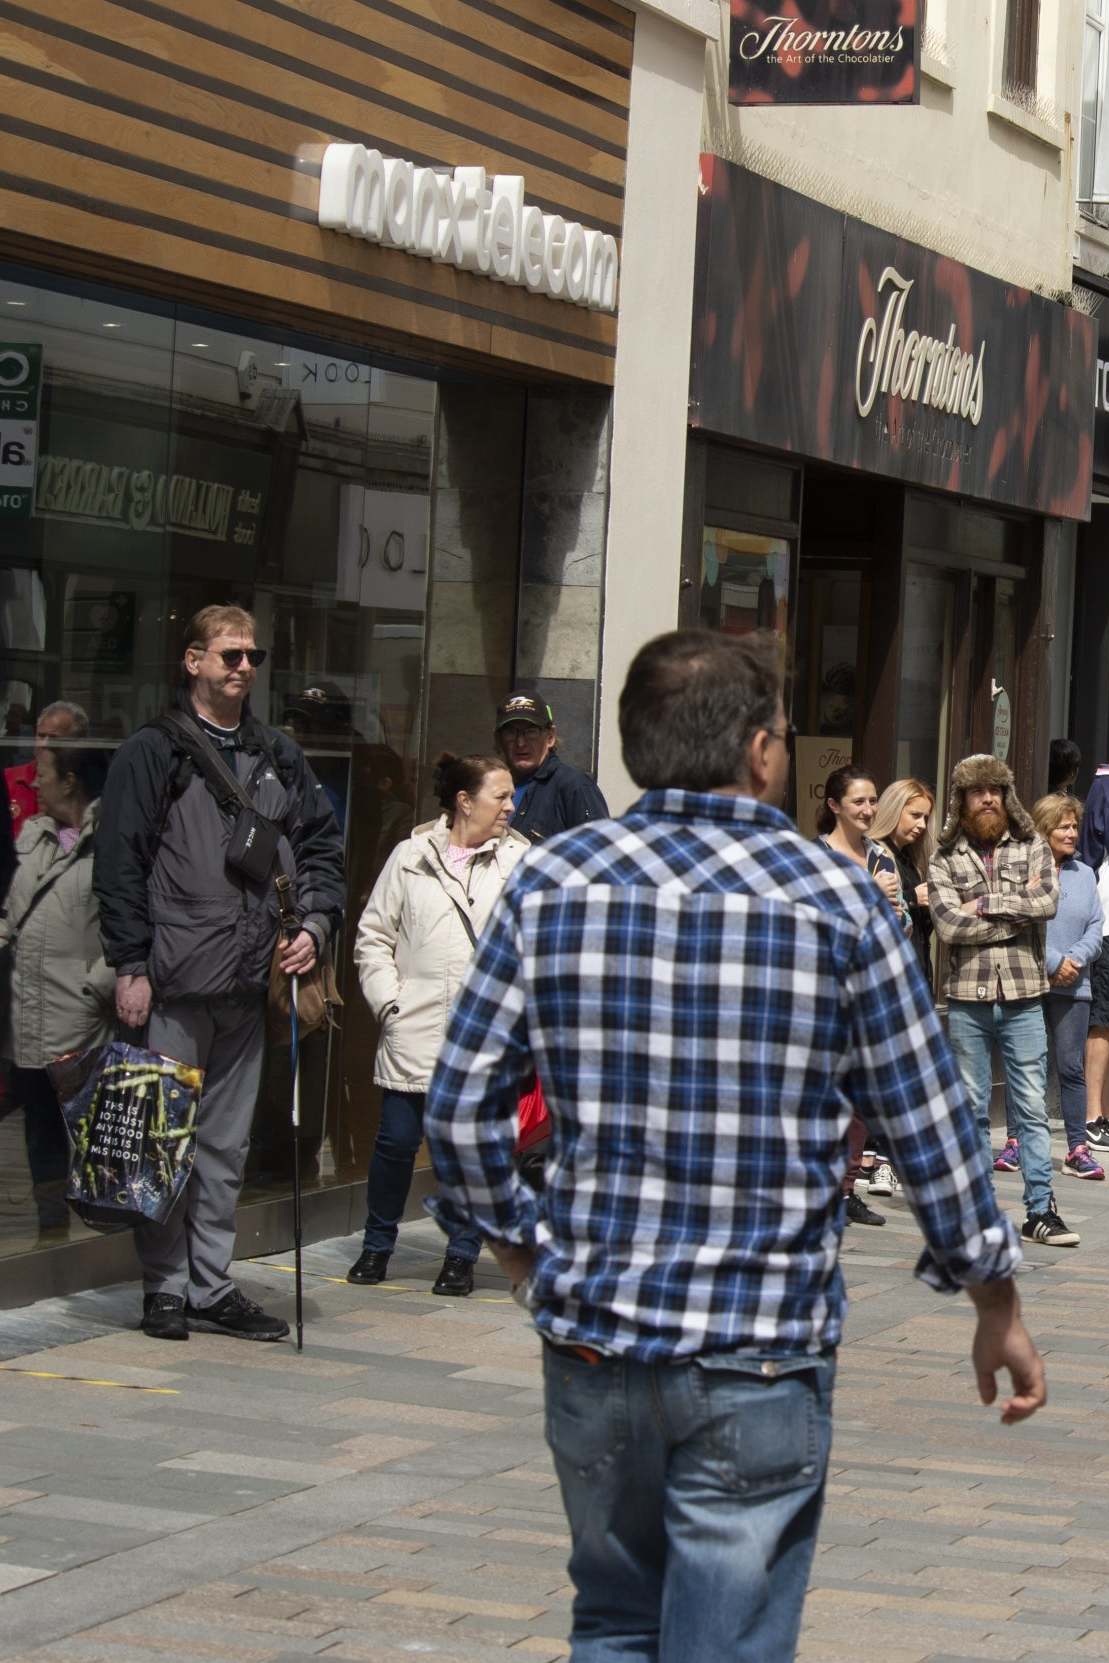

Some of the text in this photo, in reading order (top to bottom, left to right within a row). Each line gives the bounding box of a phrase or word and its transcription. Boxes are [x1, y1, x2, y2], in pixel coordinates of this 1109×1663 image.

[739, 16, 904, 60] Thorntons
[766, 53, 895, 64] the Art of the Chocolatier
[856, 266, 985, 426] Thorntons
[105, 1100, 124, 1112] THS
